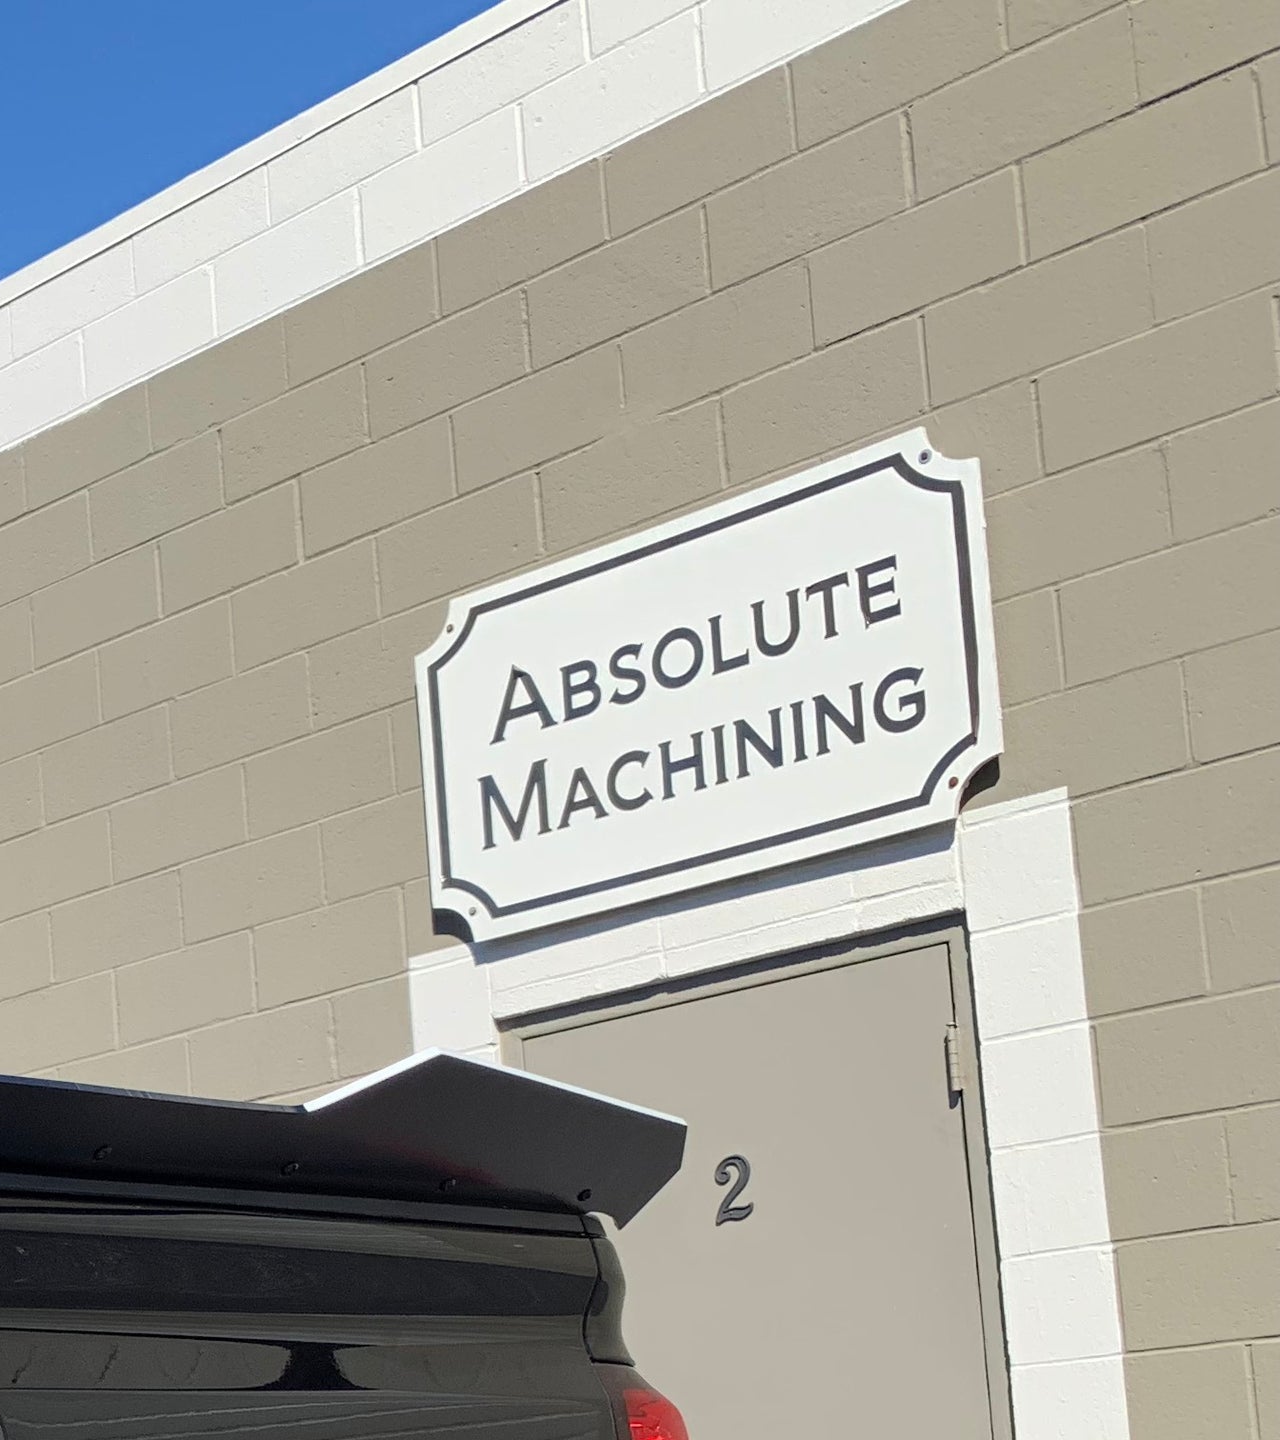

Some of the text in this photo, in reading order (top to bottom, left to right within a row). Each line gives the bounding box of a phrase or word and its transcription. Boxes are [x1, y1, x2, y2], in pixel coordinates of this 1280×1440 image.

[489, 554, 902, 745] ABSOLUTE
[476, 667, 928, 851] MACHINING
[714, 1154, 754, 1227] 2
